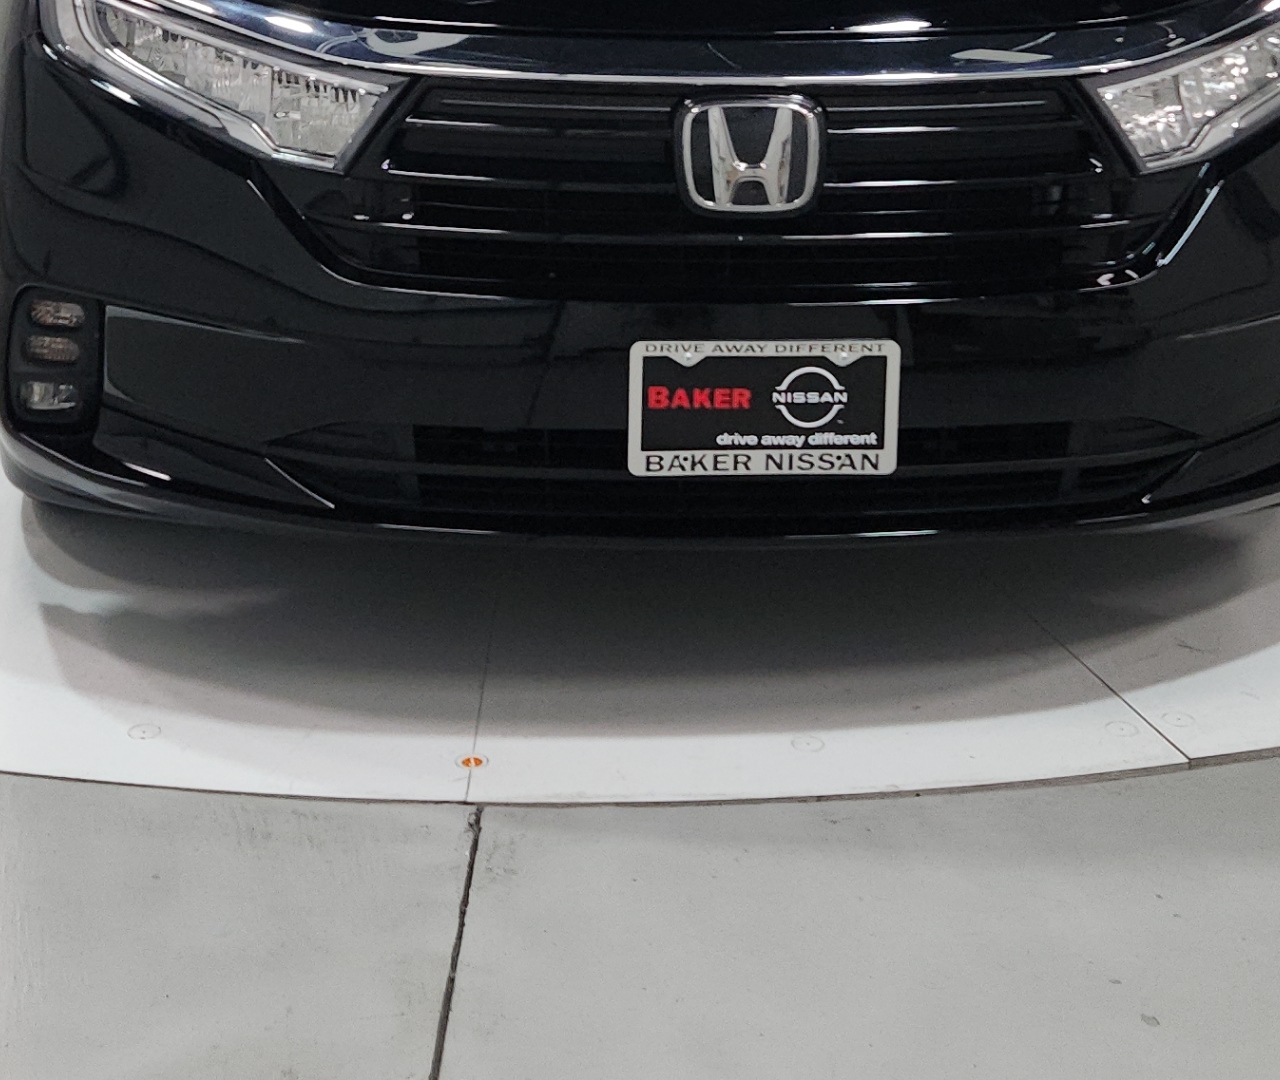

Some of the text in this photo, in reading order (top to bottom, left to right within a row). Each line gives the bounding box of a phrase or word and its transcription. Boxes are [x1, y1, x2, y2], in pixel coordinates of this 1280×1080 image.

[645, 343, 886, 354] DRIVE AWAY DIFFERENT
[647, 385, 848, 410] BAKER NISSAN
[716, 432, 878, 448] drive away different
[645, 453, 880, 472] BAKER NISSAN
